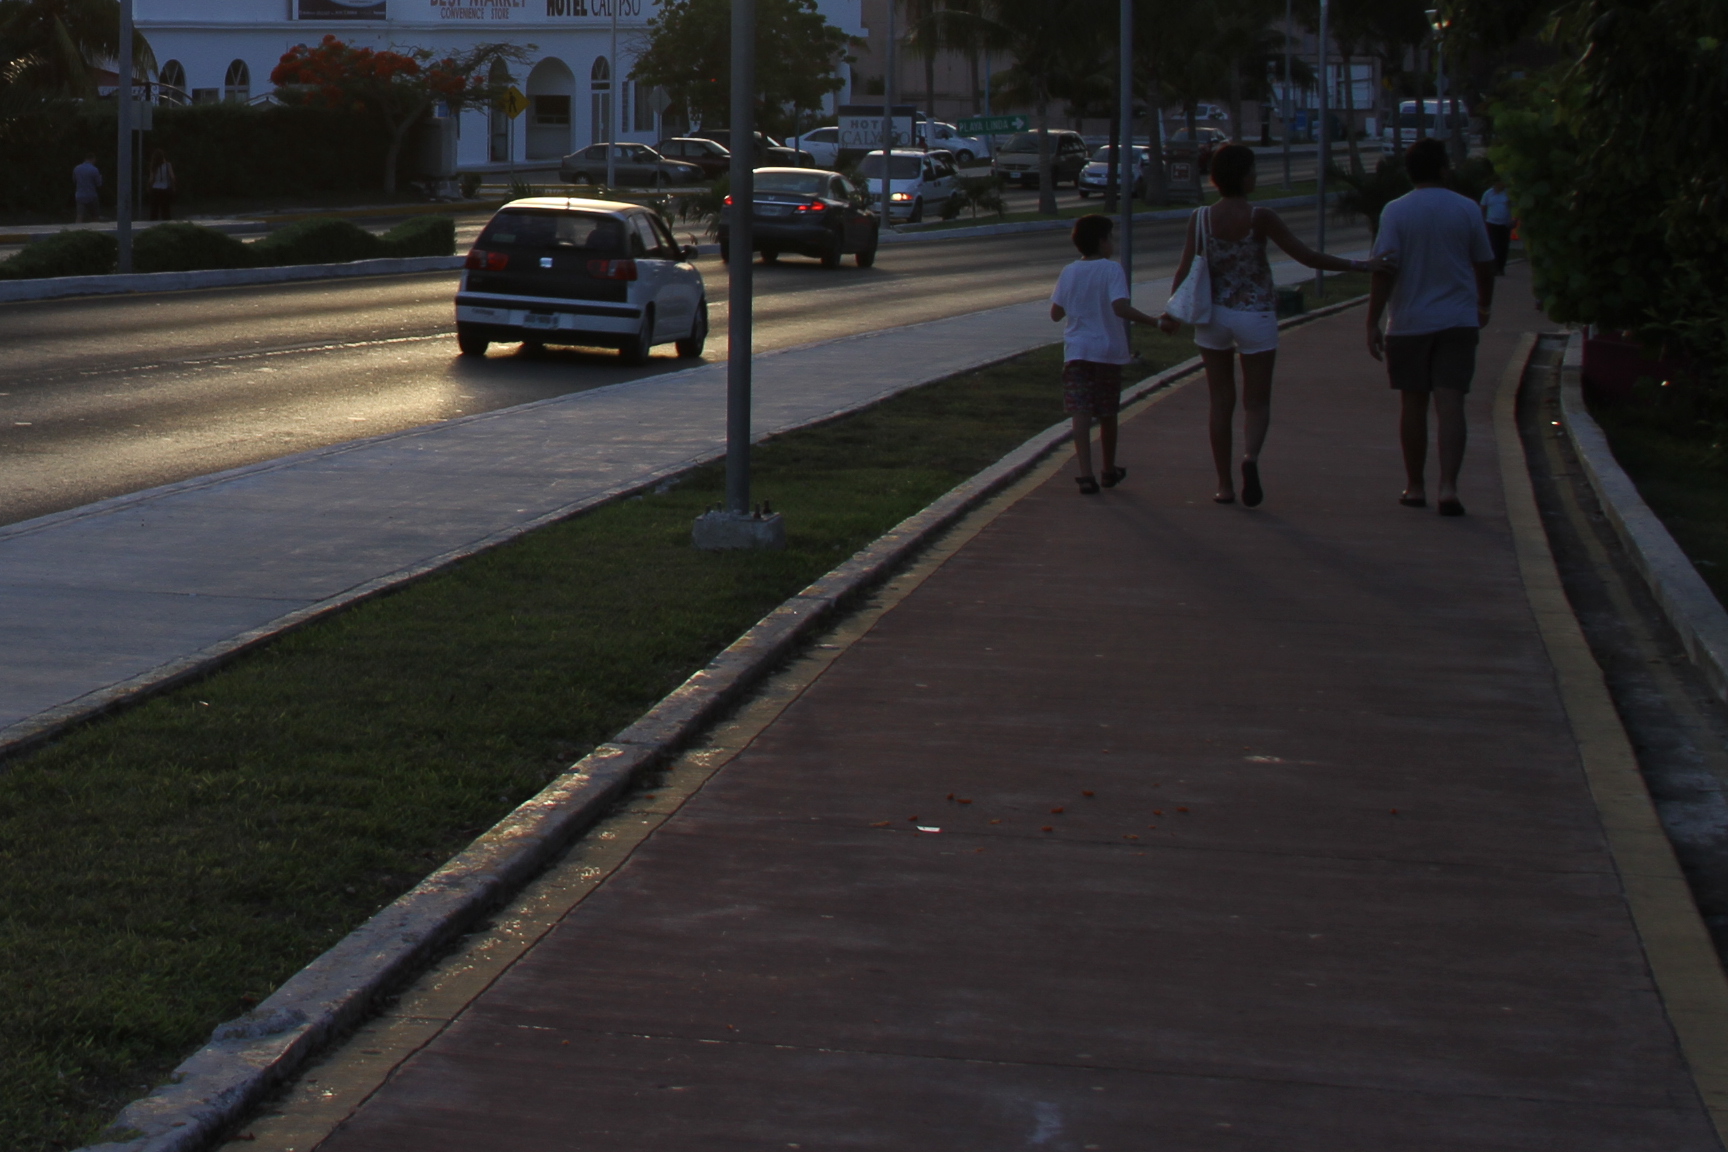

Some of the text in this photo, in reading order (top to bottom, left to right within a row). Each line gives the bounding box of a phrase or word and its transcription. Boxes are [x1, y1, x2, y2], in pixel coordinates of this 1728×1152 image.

[440, 7, 509, 20] CONVENIENCE STORE
[850, 120, 897, 129] HOTL
[959, 120, 1009, 132] PLAYA LINDA
[842, 130, 911, 145] CALYO
